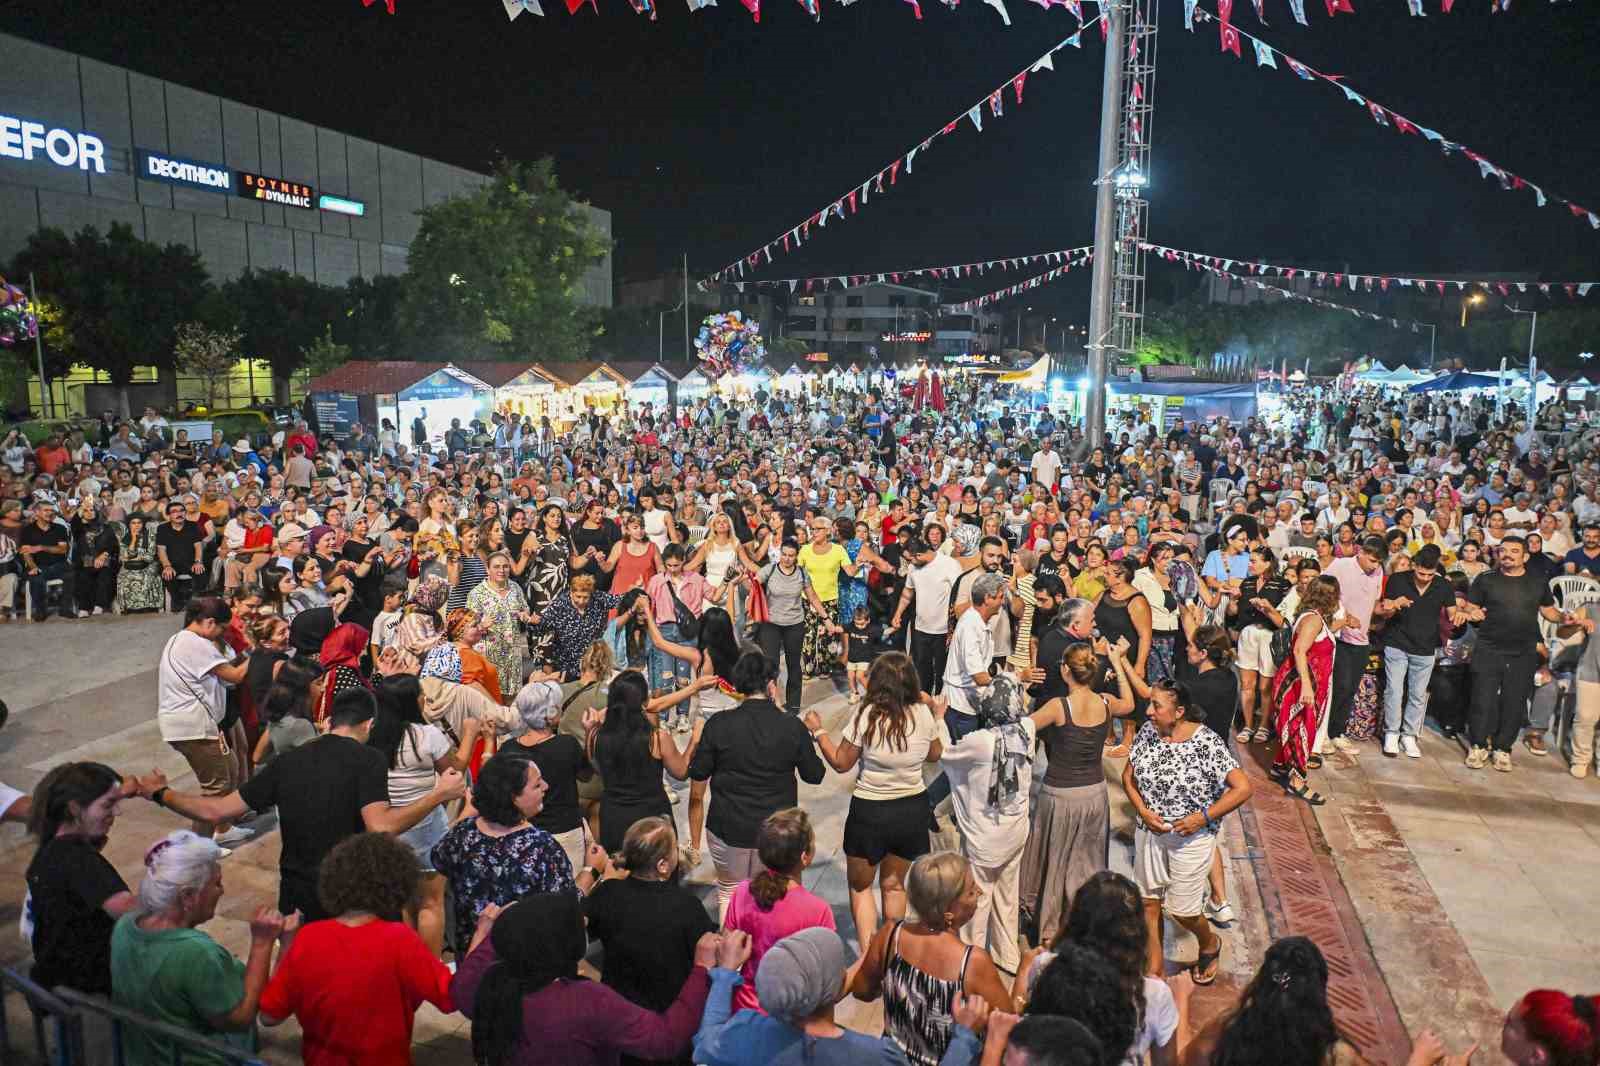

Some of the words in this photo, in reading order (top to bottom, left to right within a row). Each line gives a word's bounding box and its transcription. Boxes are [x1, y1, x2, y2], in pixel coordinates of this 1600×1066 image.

[0, 115, 106, 173] EFOR
[148, 156, 230, 189] DECATHLON
[244, 173, 313, 198] BOYNER
[265, 189, 311, 208] DYNAMIC
